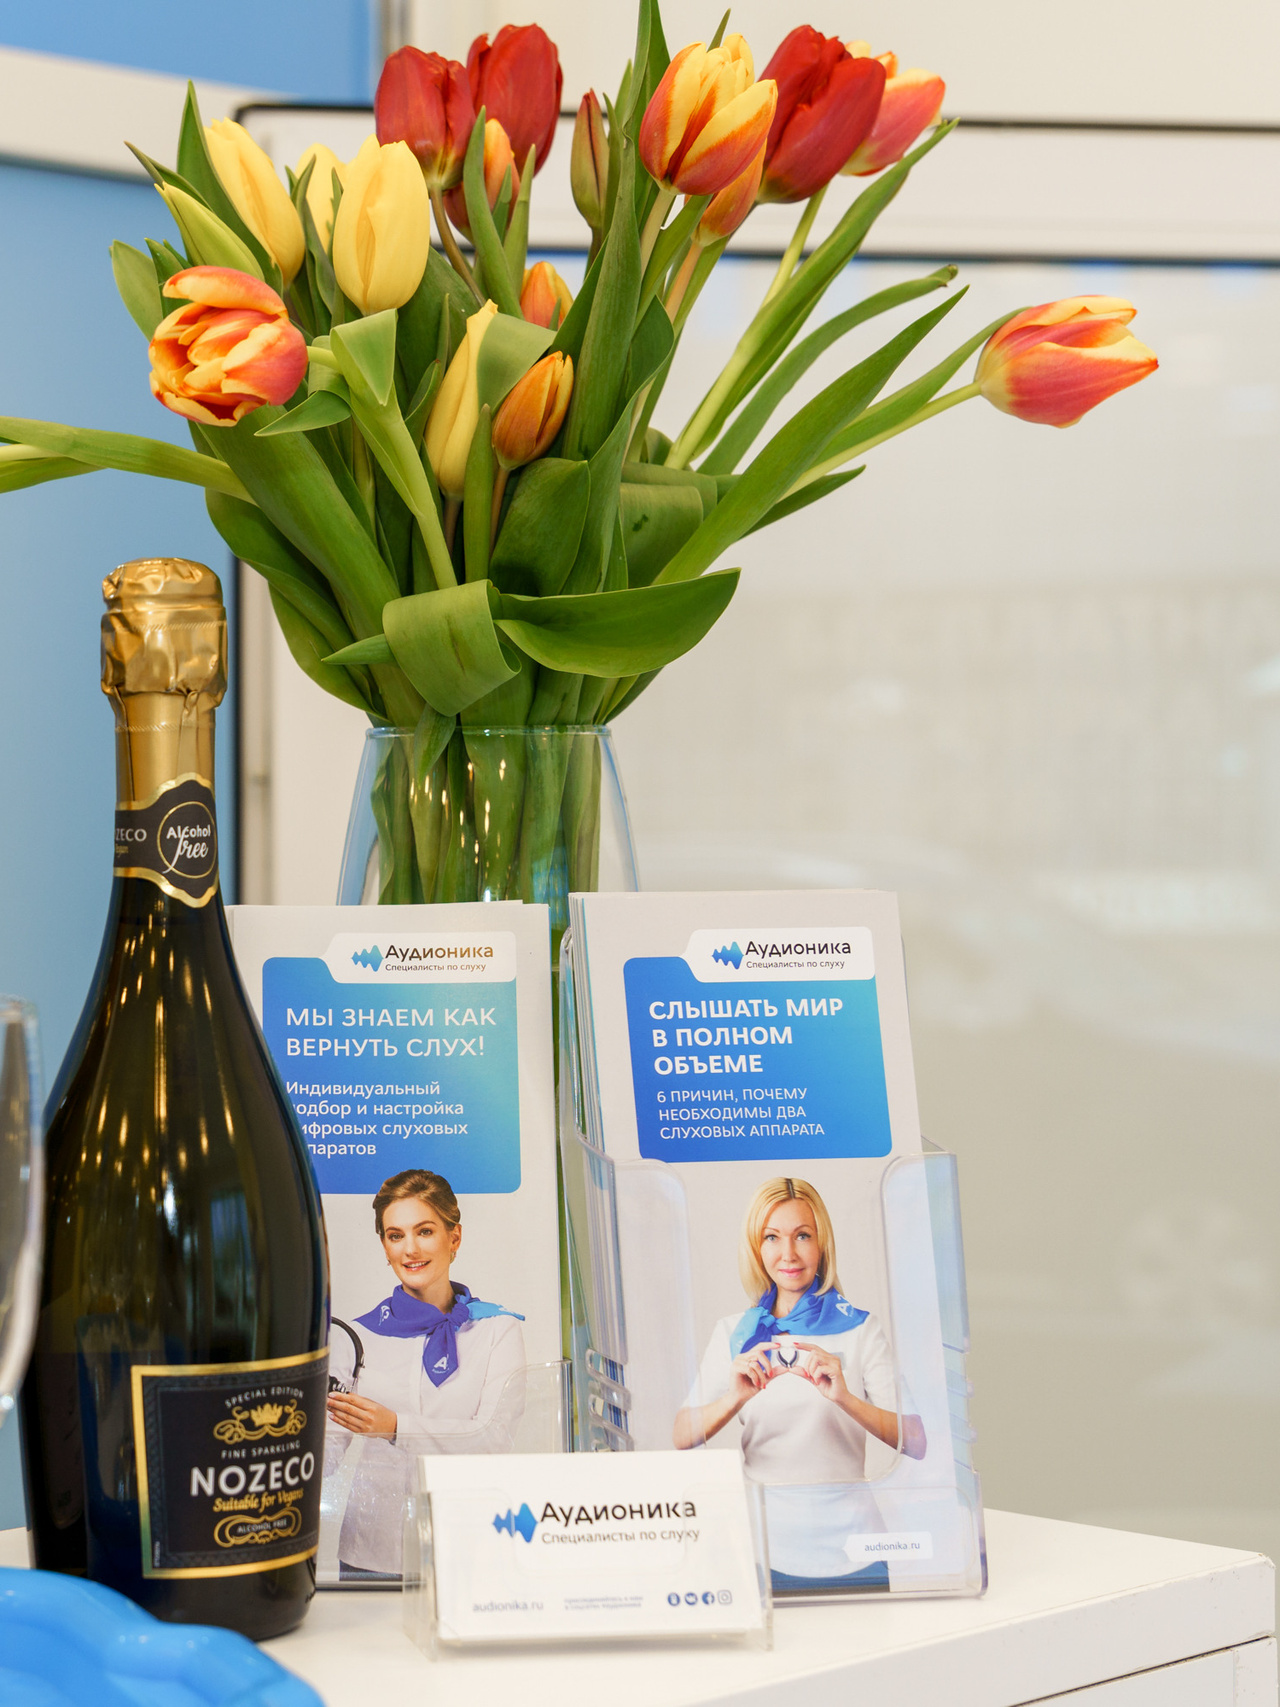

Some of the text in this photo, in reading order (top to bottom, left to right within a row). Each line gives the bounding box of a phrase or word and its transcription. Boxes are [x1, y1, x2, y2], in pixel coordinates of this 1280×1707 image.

[116, 828, 147, 842] ZECO
[166, 824, 211, 839] Alcohol
[162, 826, 209, 874] free
[384, 944, 494, 963] Аудионика
[745, 940, 852, 959] Аудионика
[385, 963, 444, 972] Специалисты
[460, 962, 487, 973] слуху
[746, 960, 805, 969] Специалисты
[819, 959, 846, 970] слуху
[285, 1007, 497, 1027] МЫ ЗНАЕМ КАК
[648, 998, 843, 1020] СЛЫШАТЬ МИР
[285, 1035, 485, 1057] ВЕРНУТЬ СЛУХ!
[652, 1026, 793, 1047] В ПОЛНОМ
[653, 1054, 763, 1075] ОБЪЕМЕ
[286, 1080, 440, 1099] Индивидуальный
[656, 1087, 808, 1103] 6 ПРИЧИН, ПОЧЕМУ
[292, 1100, 464, 1119] одбор и настройка
[659, 1106, 807, 1122] НЕОБХОДИМЫ ДВА
[301, 1121, 469, 1139] ифровых слуховых
[660, 1123, 825, 1140] СЛУХОВЫХ АППАРАТА
[307, 1143, 377, 1159] паратов
[224, 1386, 305, 1409] SPECIAL EDITION
[221, 1439, 301, 1460] FINE SPARKLING
[190, 1451, 315, 1497] NOZECO
[212, 1494, 260, 1513] Suitable
[258, 1491, 276, 1513] for
[540, 1501, 697, 1527] Аудионика
[237, 1522, 272, 1534] ALCOHOL
[541, 1529, 700, 1545] Специалисты по слуху
[864, 1541, 920, 1552] audionika.ru
[472, 1600, 544, 1613] audionika.ru
